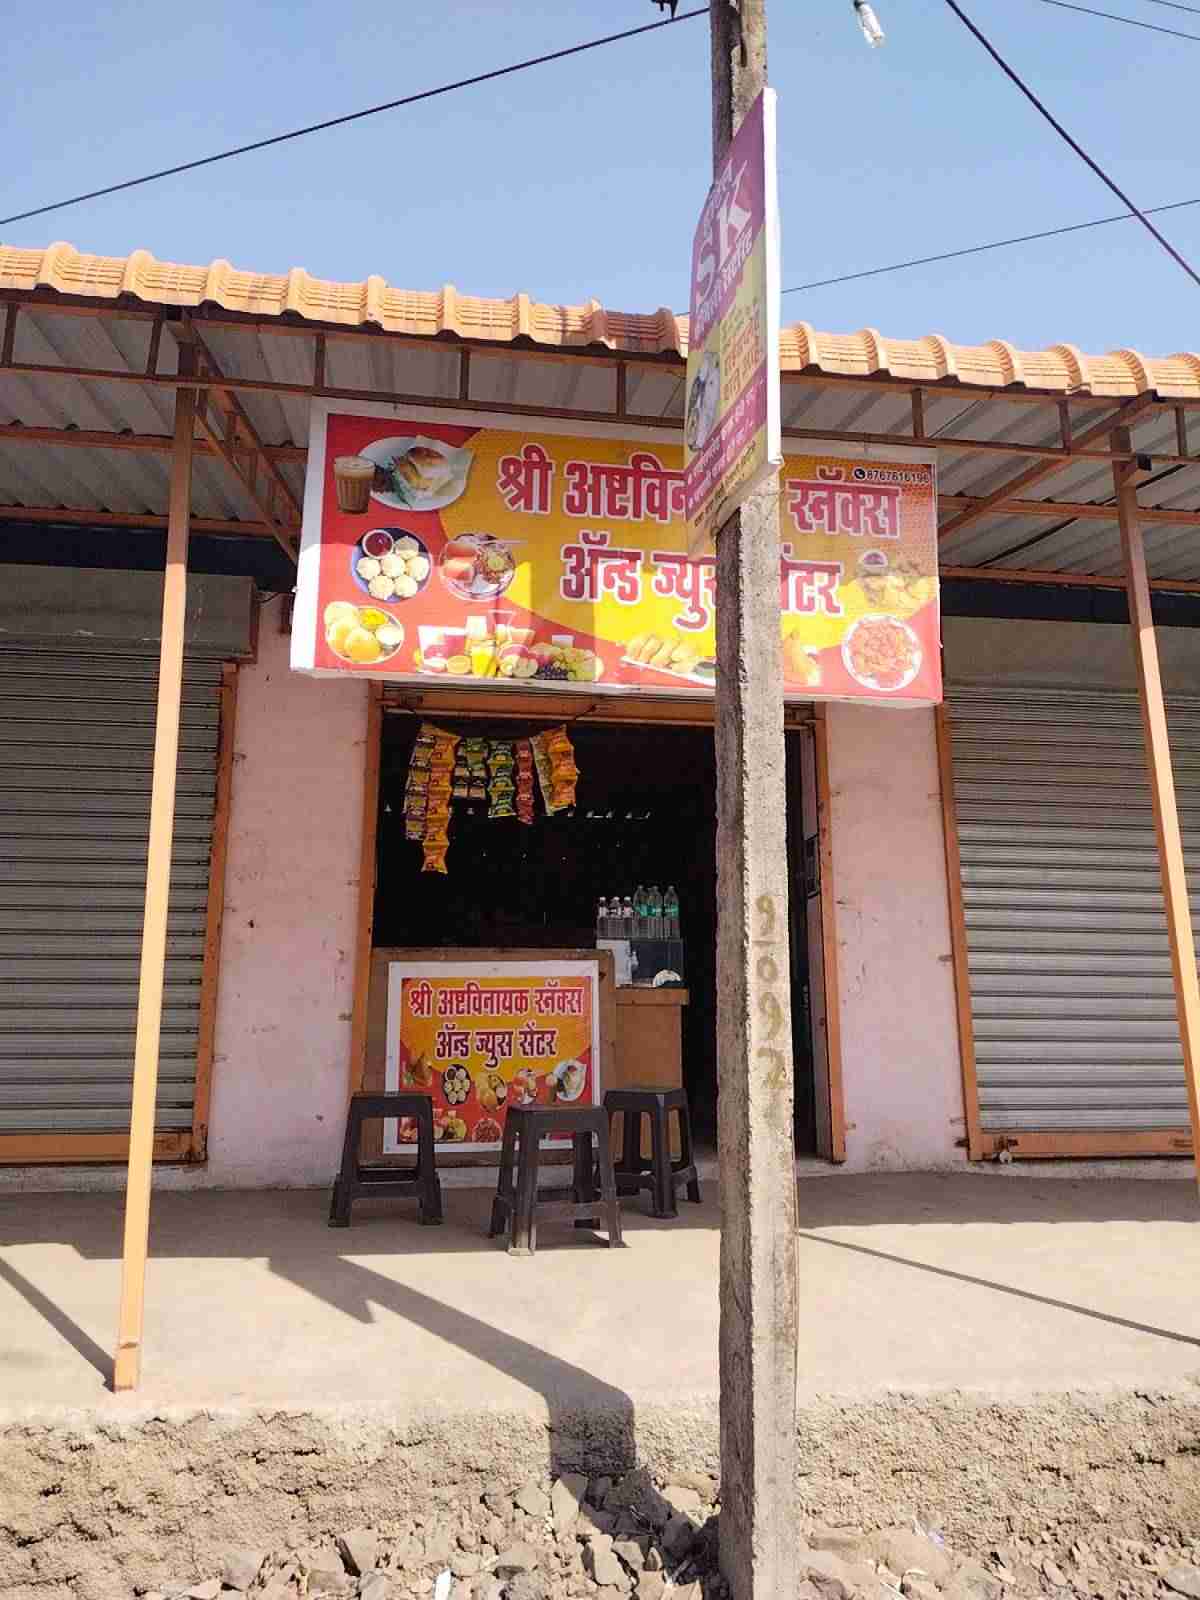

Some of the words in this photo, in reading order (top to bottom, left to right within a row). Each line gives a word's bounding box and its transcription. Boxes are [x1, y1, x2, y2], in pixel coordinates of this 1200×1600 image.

[499, 445, 552, 513] श्री
[411, 983, 432, 1015] श्री
[438, 983, 529, 1015] अष्टविनायक
[476, 1031, 513, 1067] ज्युस
[519, 1022, 556, 1056] सेंटर
